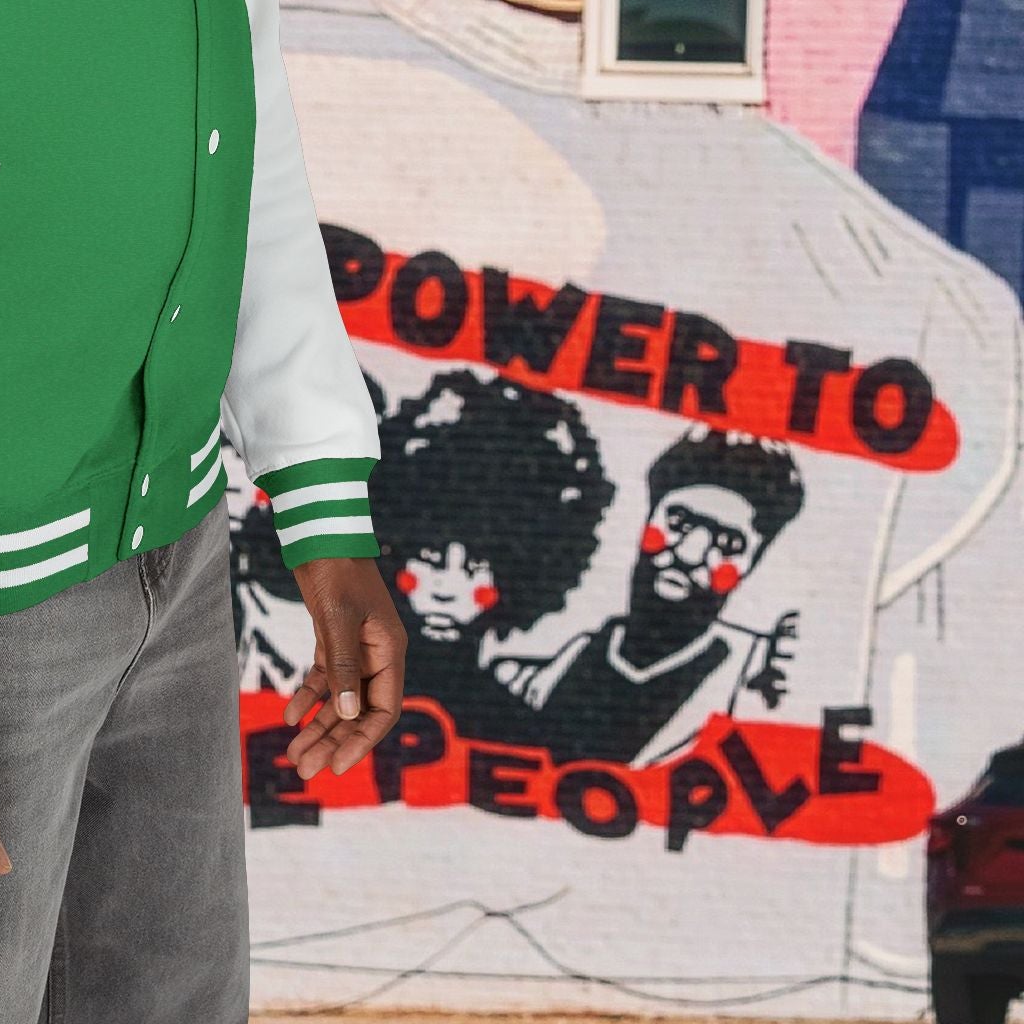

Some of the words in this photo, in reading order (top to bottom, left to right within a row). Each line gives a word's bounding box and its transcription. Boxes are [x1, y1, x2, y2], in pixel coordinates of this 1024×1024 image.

[318, 222, 739, 414] POWER
[785, 340, 935, 455] TO
[372, 706, 883, 853] PEOPLE
